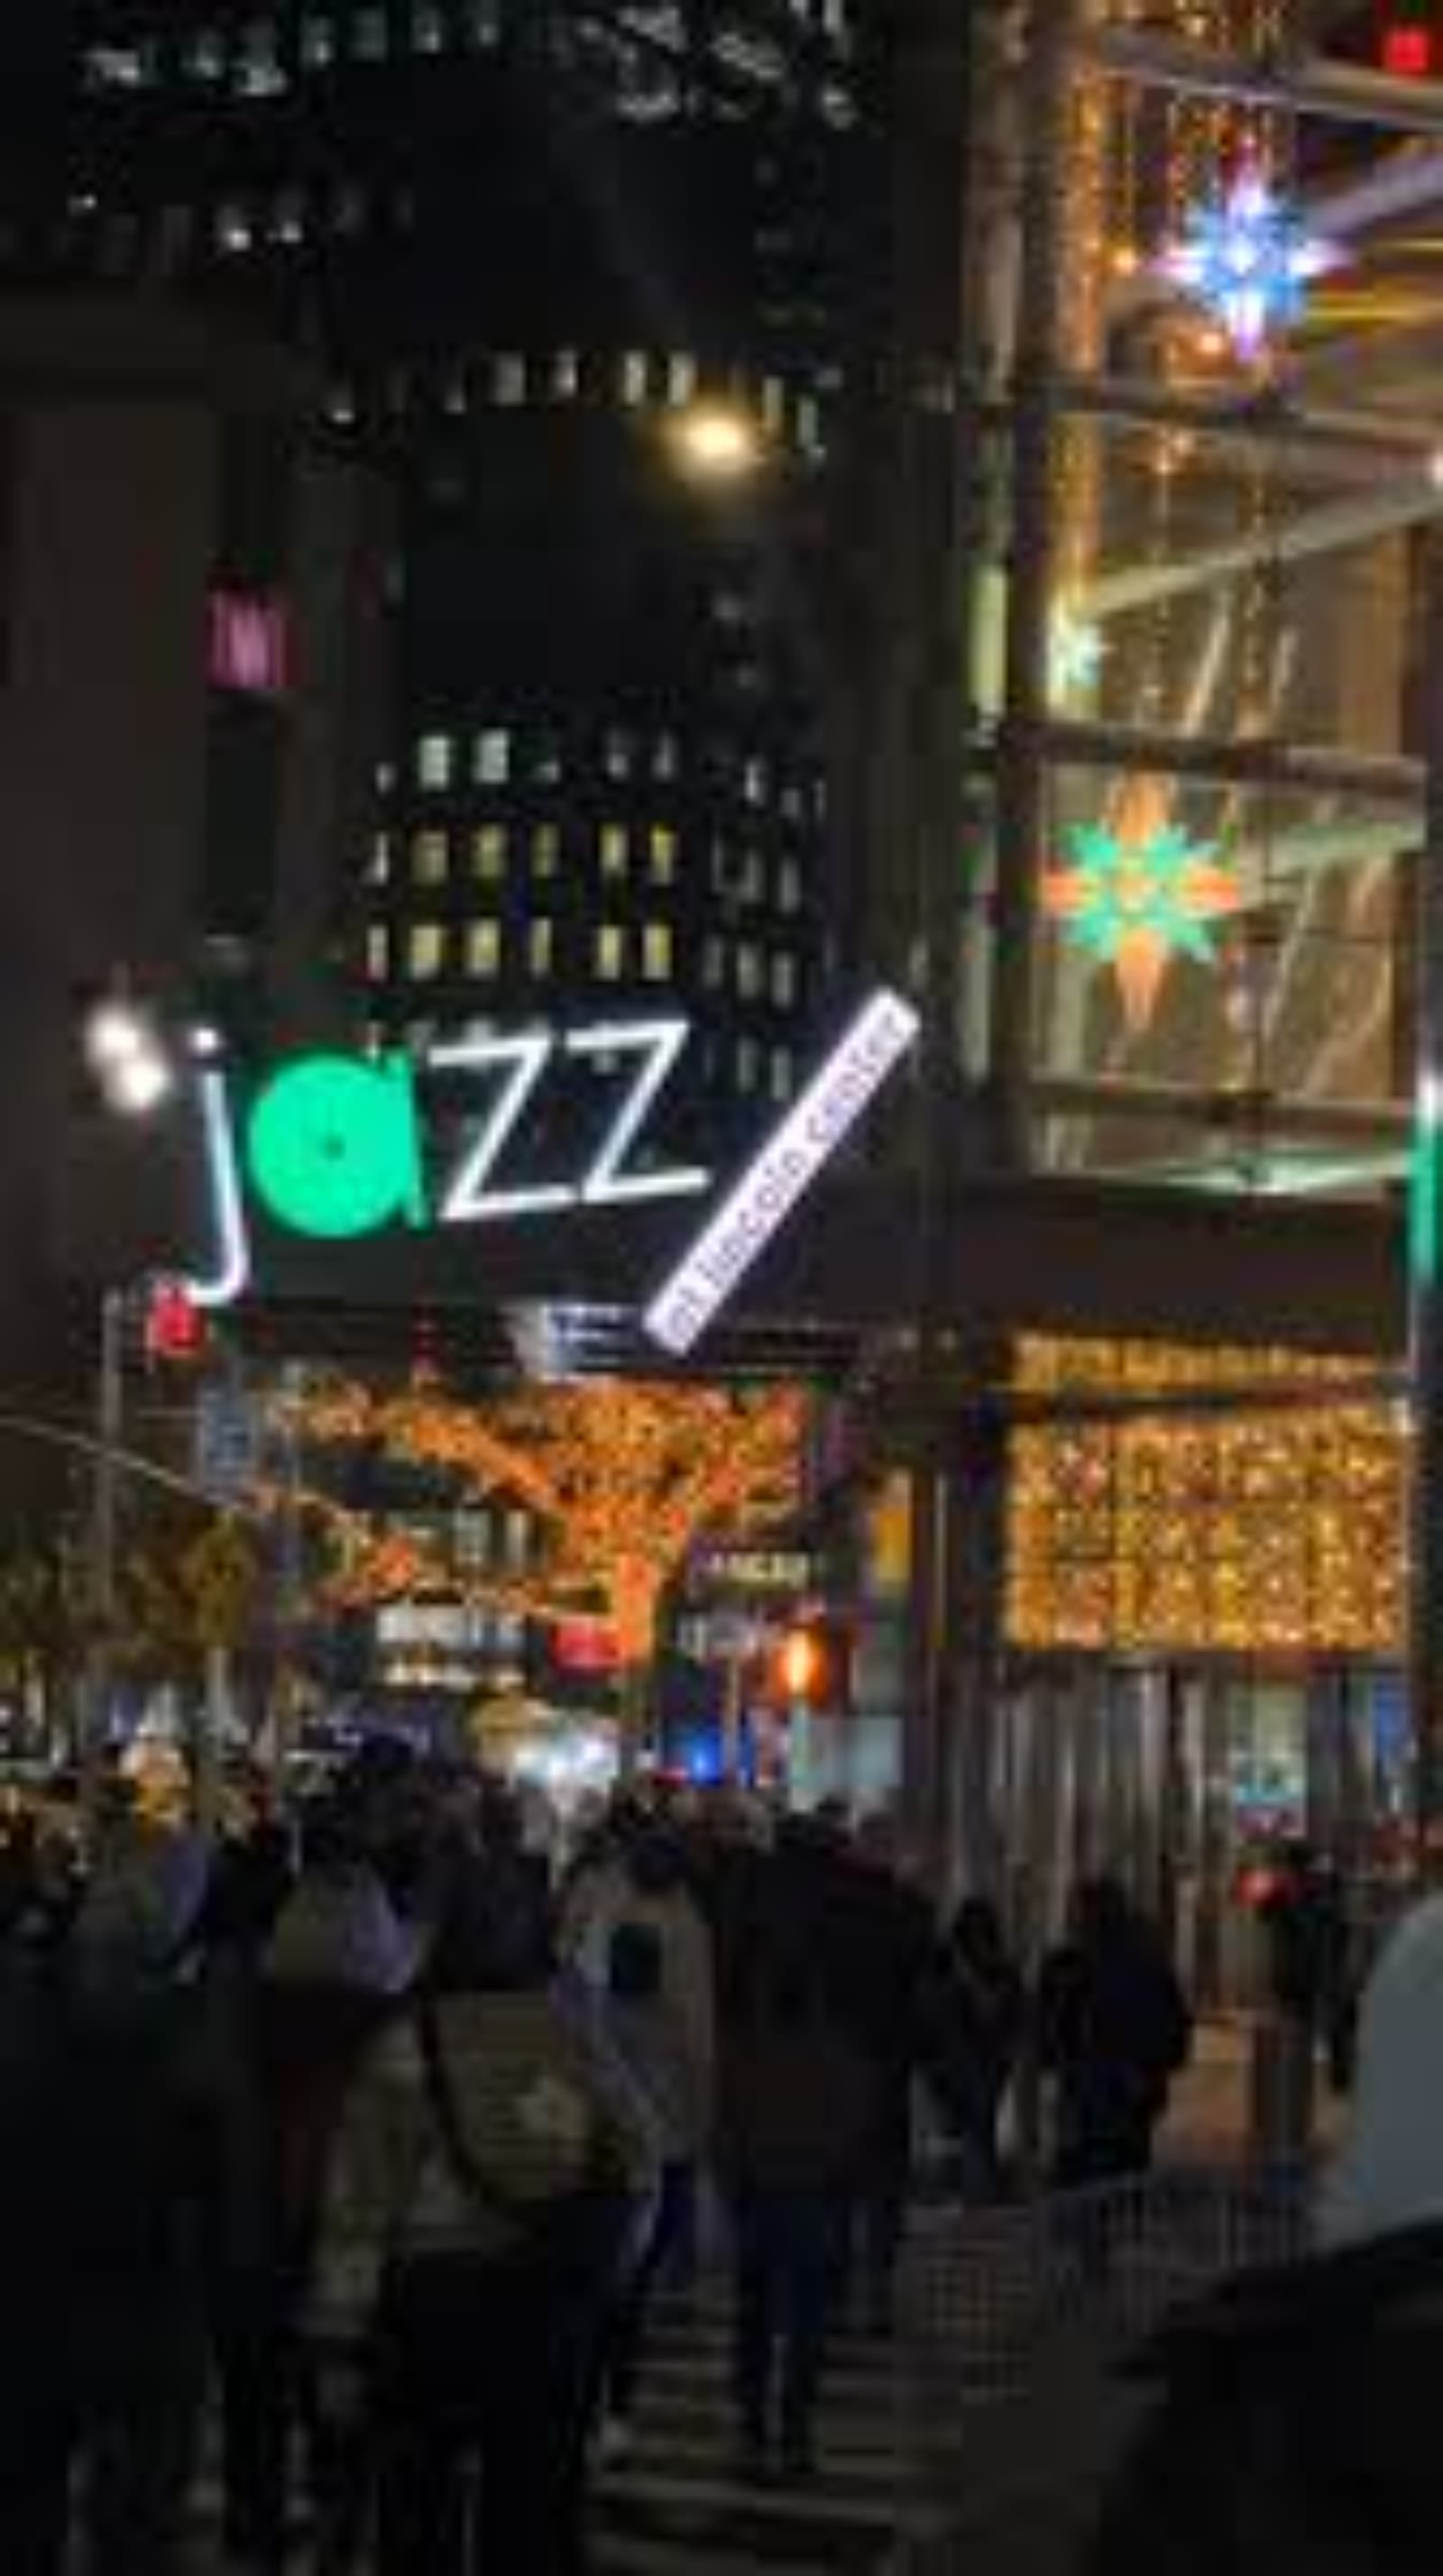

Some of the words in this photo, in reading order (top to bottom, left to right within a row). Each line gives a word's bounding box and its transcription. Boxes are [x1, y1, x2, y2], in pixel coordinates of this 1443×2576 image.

[182, 1021, 709, 1305] jazz
[693, 1145, 812, 1288] lincoln
[800, 1007, 909, 1147] center
